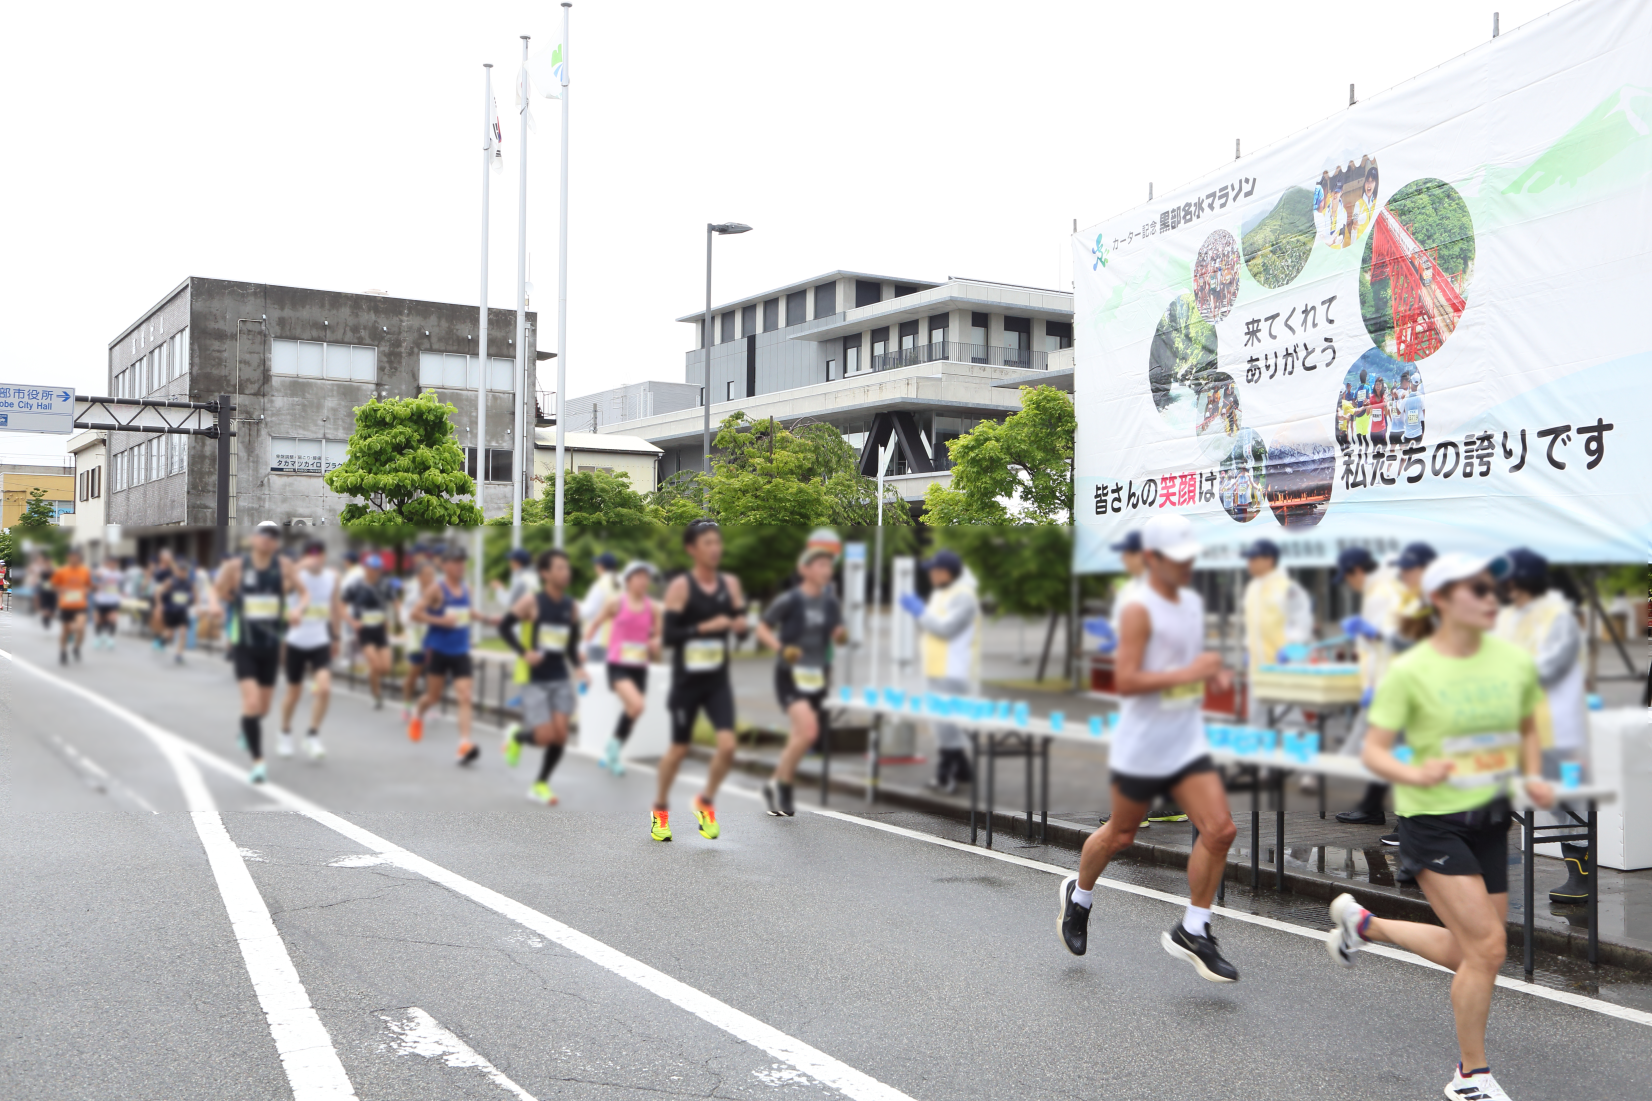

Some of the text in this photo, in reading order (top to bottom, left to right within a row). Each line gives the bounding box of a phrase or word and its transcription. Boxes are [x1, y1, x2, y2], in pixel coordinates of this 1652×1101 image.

[1112, 176, 1257, 251] カーター記念 黒部名水マラソン
[1243, 294, 1338, 348] 来てくれて
[1245, 336, 1337, 385] ありがとう
[17, 401, 34, 410] City
[36, 402, 53, 410] Hall
[1093, 417, 1615, 516] 皆さんの笑顔は 私たちの誇りです
